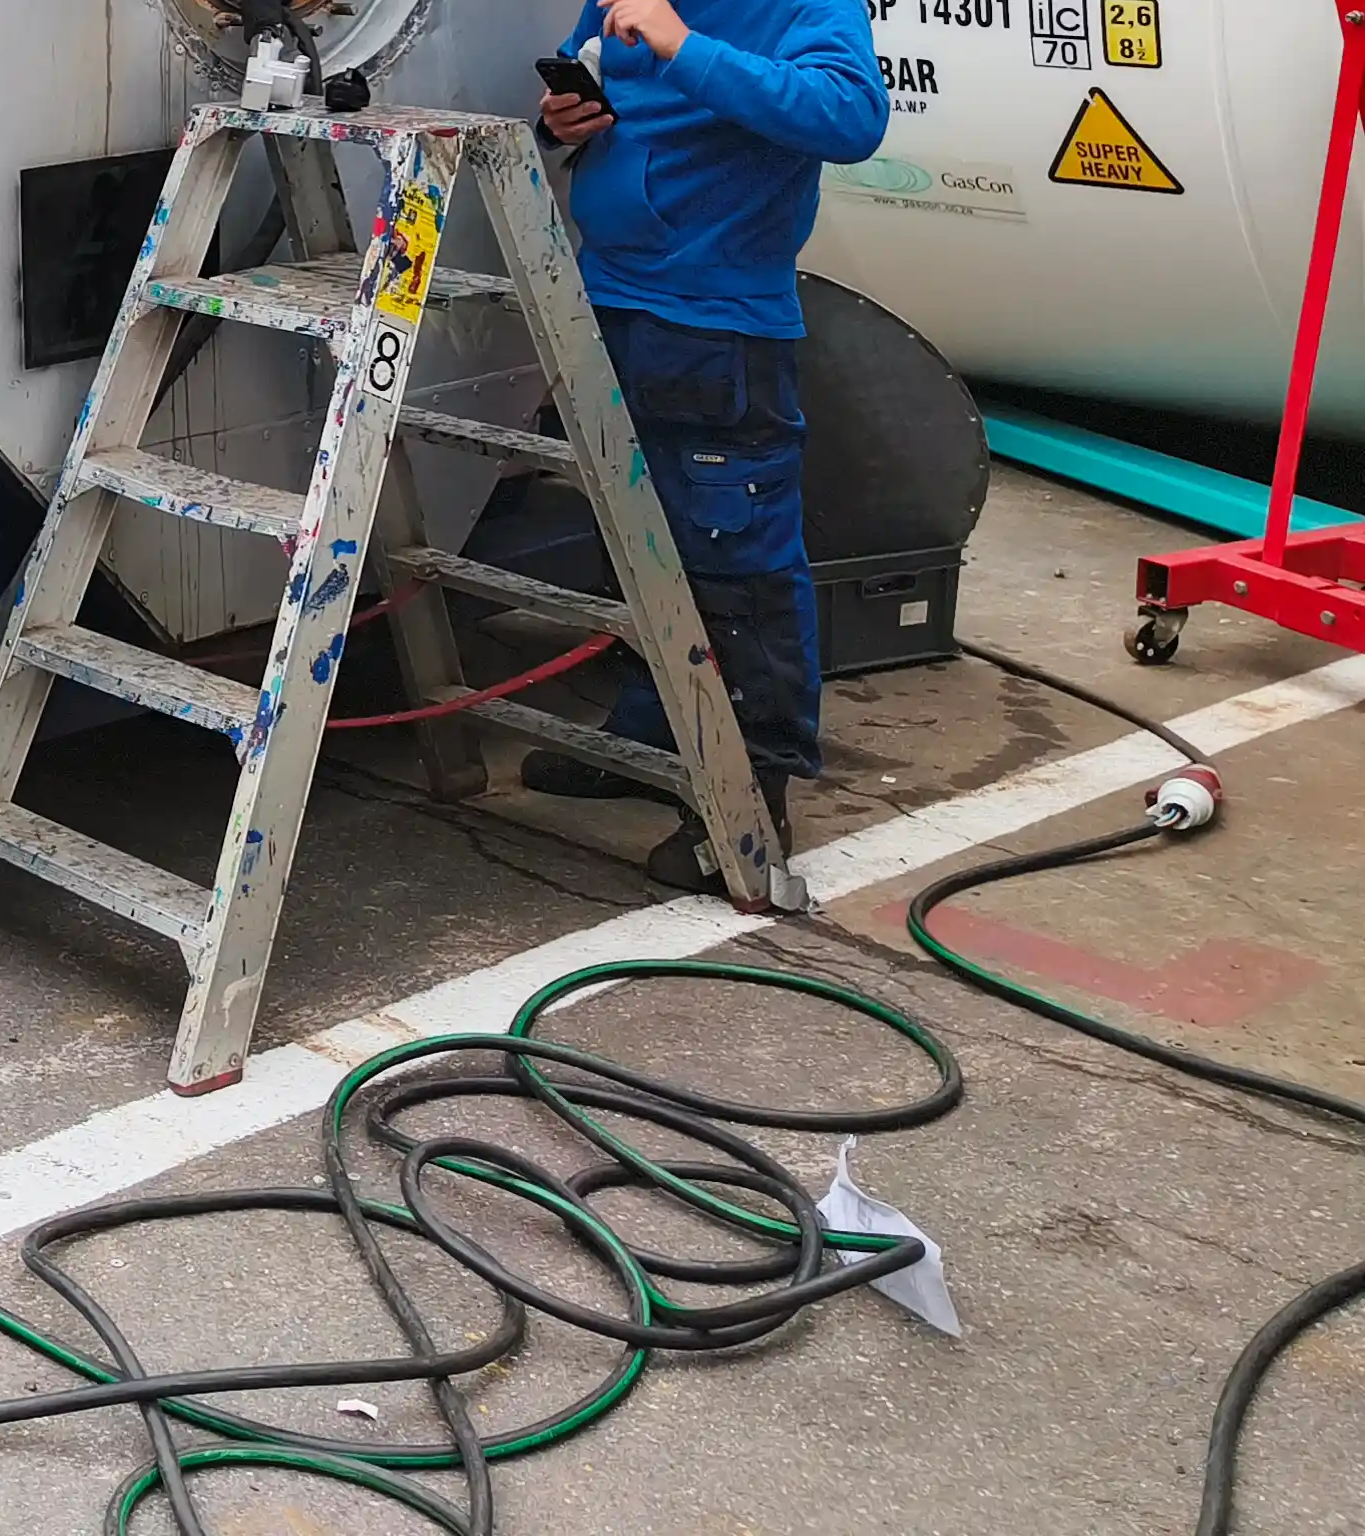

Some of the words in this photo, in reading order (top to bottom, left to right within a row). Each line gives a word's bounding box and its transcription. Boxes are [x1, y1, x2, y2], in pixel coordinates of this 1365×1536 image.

[1110, 3, 1151, 28] 2,6
[1043, 40, 1078, 66] 70
[877, 56, 939, 94] BAR
[1075, 141, 1139, 163] SUPER
[941, 172, 1014, 195] GasCon
[1080, 161, 1143, 183] HEAVY
